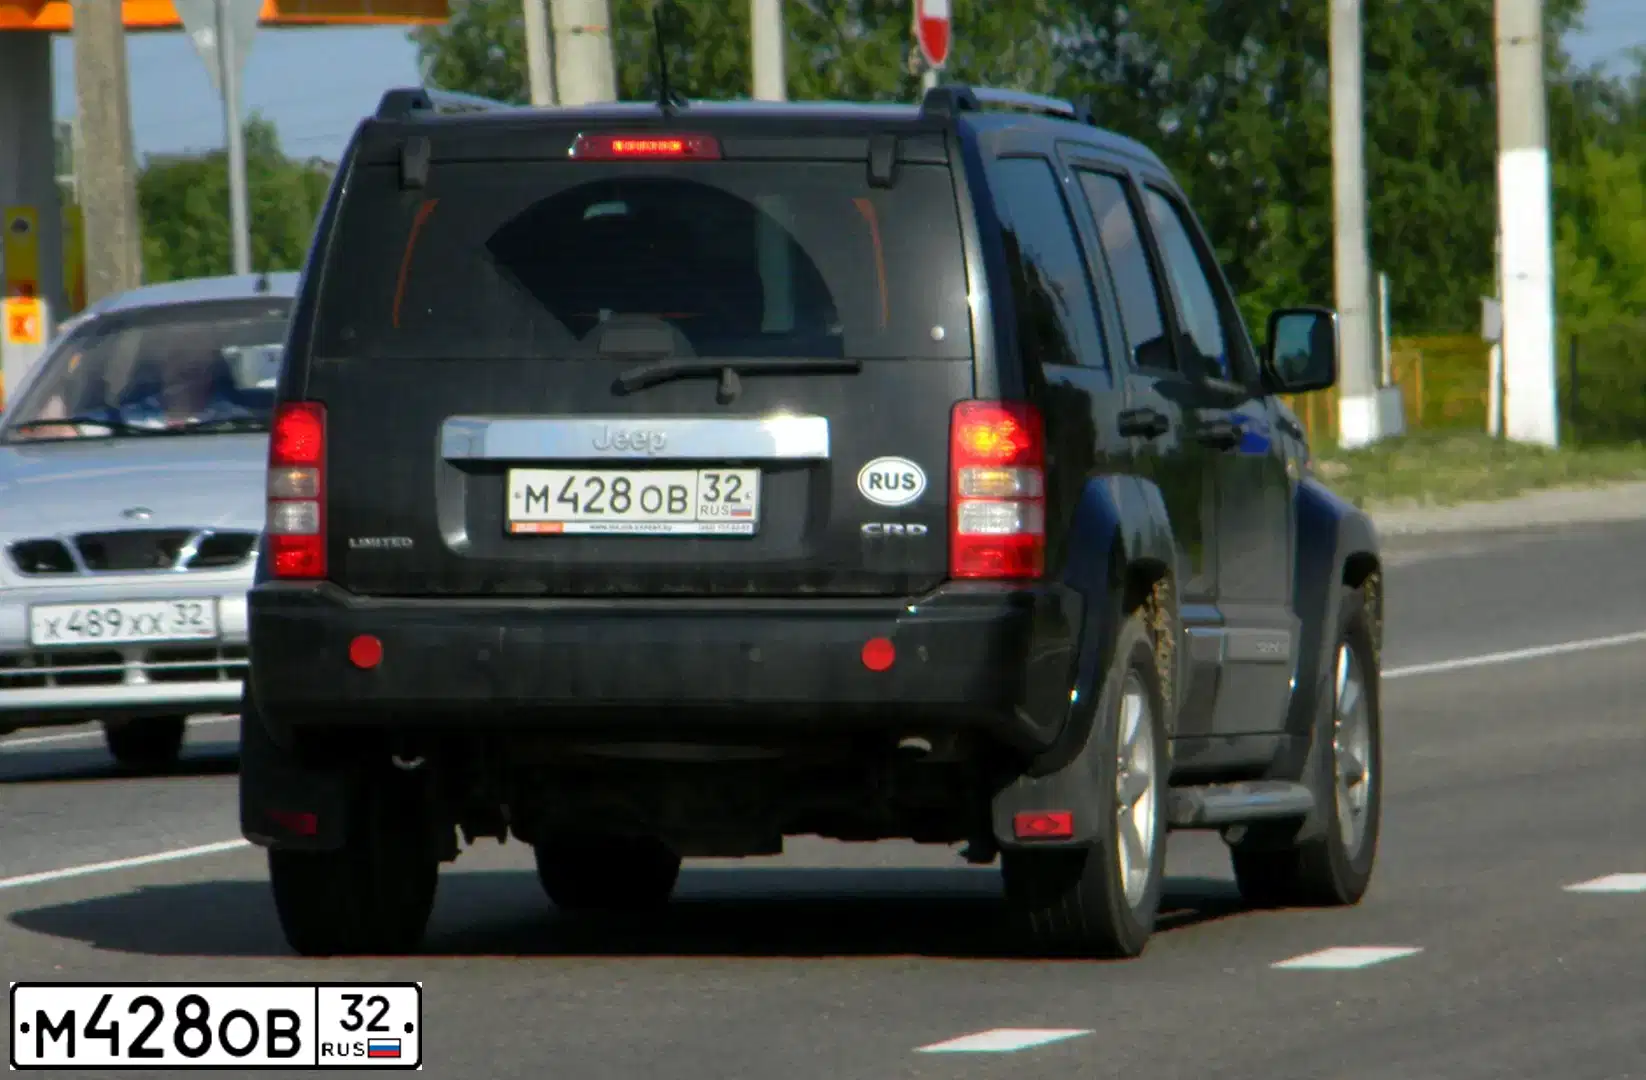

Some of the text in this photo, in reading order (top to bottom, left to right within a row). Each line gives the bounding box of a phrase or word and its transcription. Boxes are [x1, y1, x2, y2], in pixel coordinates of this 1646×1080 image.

[592, 423, 667, 456] Jeep
[703, 474, 743, 503] 32
[868, 471, 917, 491] RUS
[700, 504, 730, 516] RUS
[861, 522, 929, 537] CRD
[173, 603, 204, 626] 32
